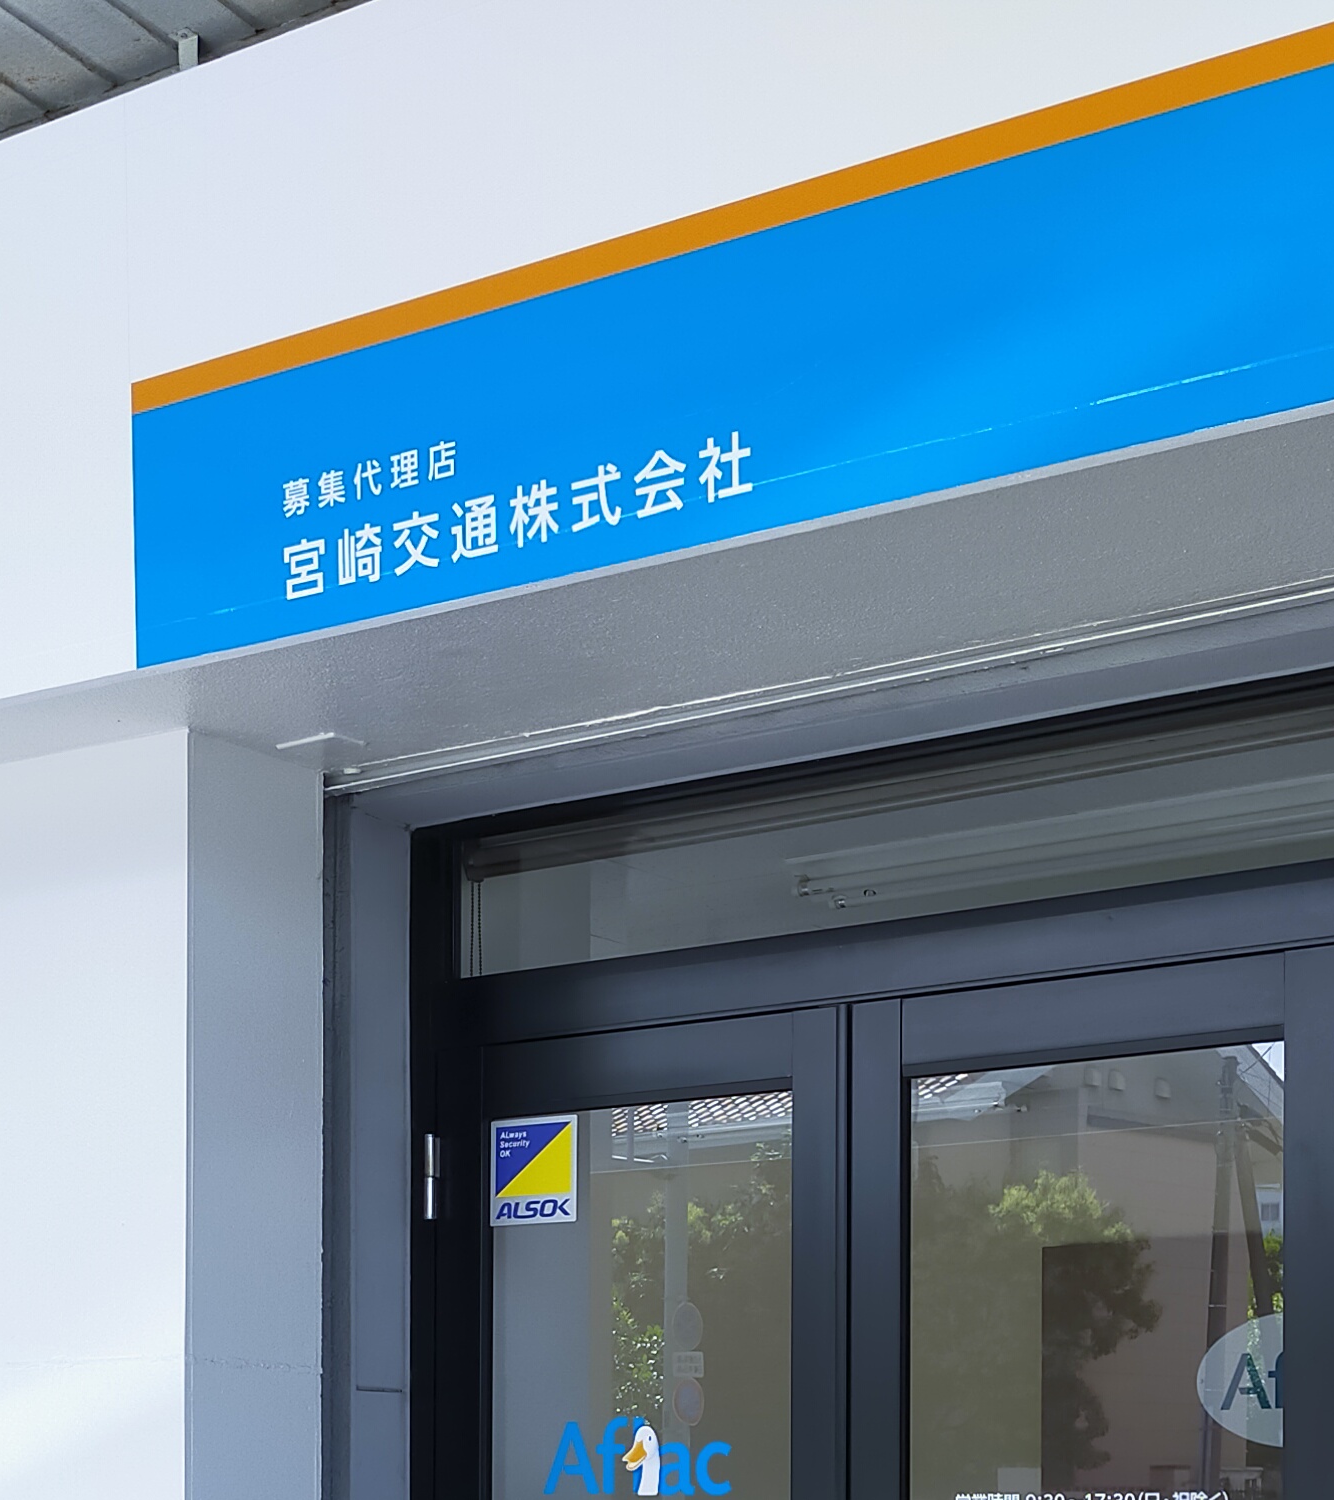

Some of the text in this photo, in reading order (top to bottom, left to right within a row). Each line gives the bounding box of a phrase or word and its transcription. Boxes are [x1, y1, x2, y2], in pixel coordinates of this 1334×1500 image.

[281, 439, 459, 518] 募集代理店
[282, 431, 755, 602] 宮崎交通株式会社
[499, 1140, 530, 1149] Security
[499, 1150, 511, 1158] OK
[495, 1198, 572, 1220] ALSOK
